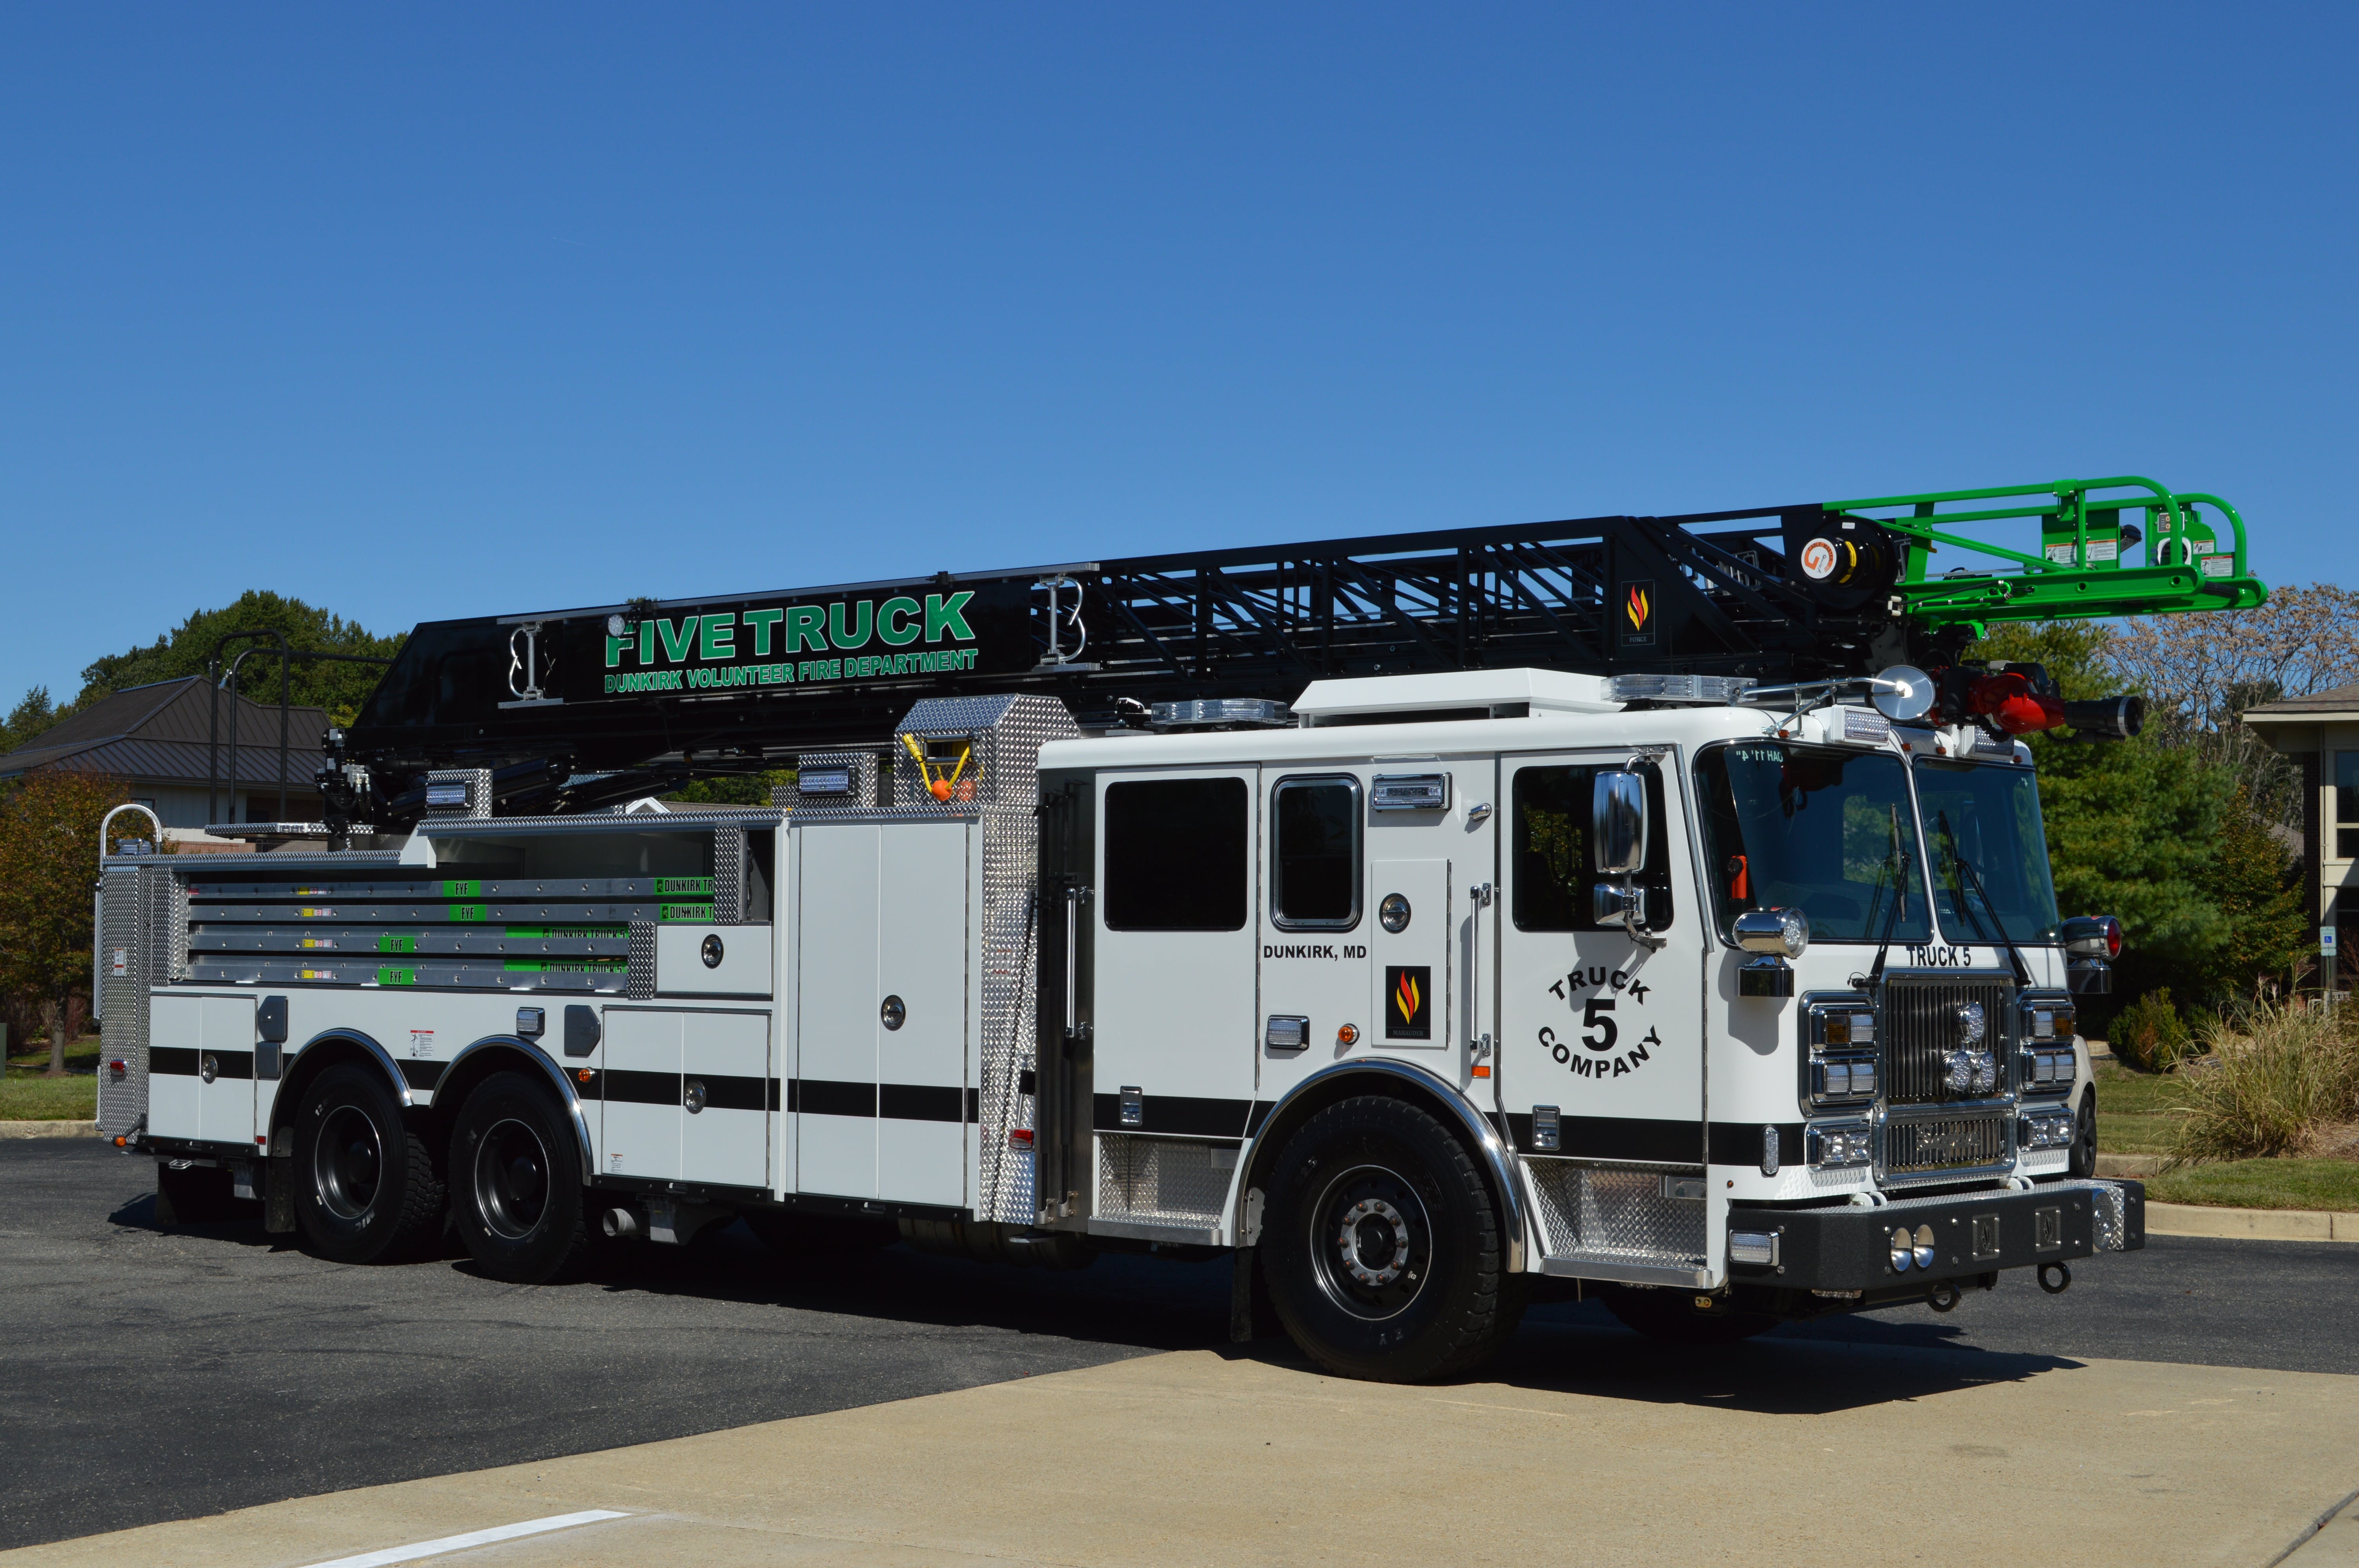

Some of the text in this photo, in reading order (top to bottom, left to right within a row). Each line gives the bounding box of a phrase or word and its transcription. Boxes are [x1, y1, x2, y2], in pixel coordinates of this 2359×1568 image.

[606, 591, 975, 667] FIVE TRUCK
[605, 648, 978, 693] DUNKIRK VOLUNTEER FIRE DEPARTMENT
[455, 882, 468, 896] FYF
[665, 879, 701, 893] DUNKIRK
[461, 906, 474, 920] FYF
[670, 906, 706, 919] DUNKIRK
[552, 928, 588, 938] DUNKIRK
[590, 929, 618, 938] TRUCK
[391, 938, 403, 952] FYF
[1264, 945, 1367, 961] DUNKIRK, MD
[1906, 945, 1971, 966] TRUCK 5
[550, 963, 586, 973] DUNKIRK
[588, 964, 615, 973] TRUCK
[390, 970, 402, 984] FYF
[1548, 967, 1651, 1005] TRUCK
[1581, 998, 1618, 1051] 5
[1538, 1024, 1662, 1079] COMPANY
